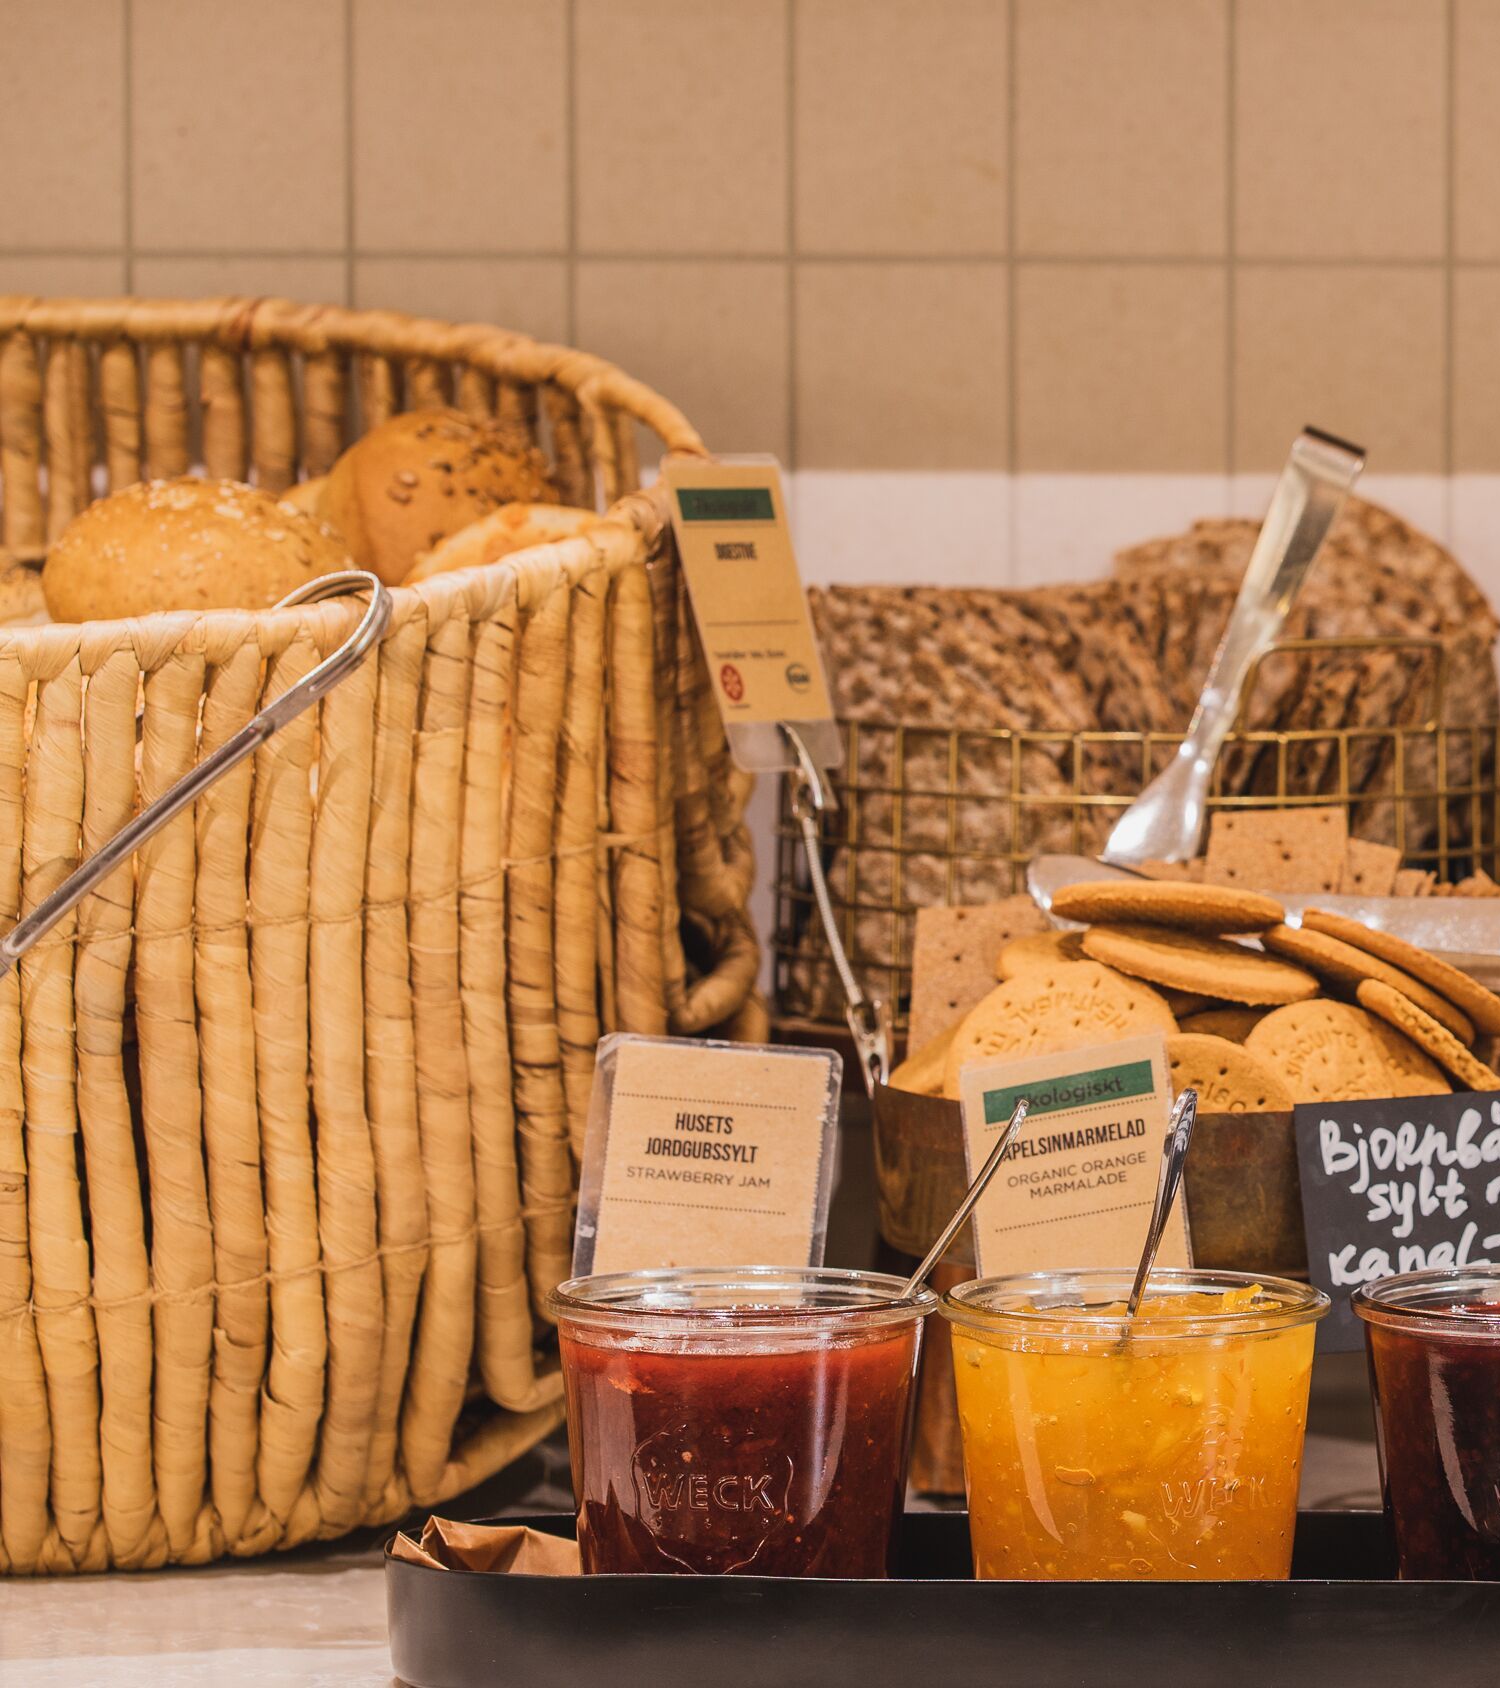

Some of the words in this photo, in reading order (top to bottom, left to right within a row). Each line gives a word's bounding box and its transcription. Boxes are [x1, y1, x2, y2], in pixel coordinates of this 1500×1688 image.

[675, 1113, 734, 1135] HUSETS
[1002, 1118, 1146, 1162] APELSINMARMELAD
[644, 1137, 759, 1164] JORDGUBSSYLT
[626, 1166, 734, 1187] STRAWBERRY
[738, 1174, 771, 1189] JAM
[1007, 1164, 1078, 1188] ORGANIC
[1082, 1151, 1147, 1172] ORANGE
[1029, 1170, 1127, 1200] MARMALADE
[1366, 1165, 1469, 1238] sylt
[643, 1472, 775, 1513] WECK
